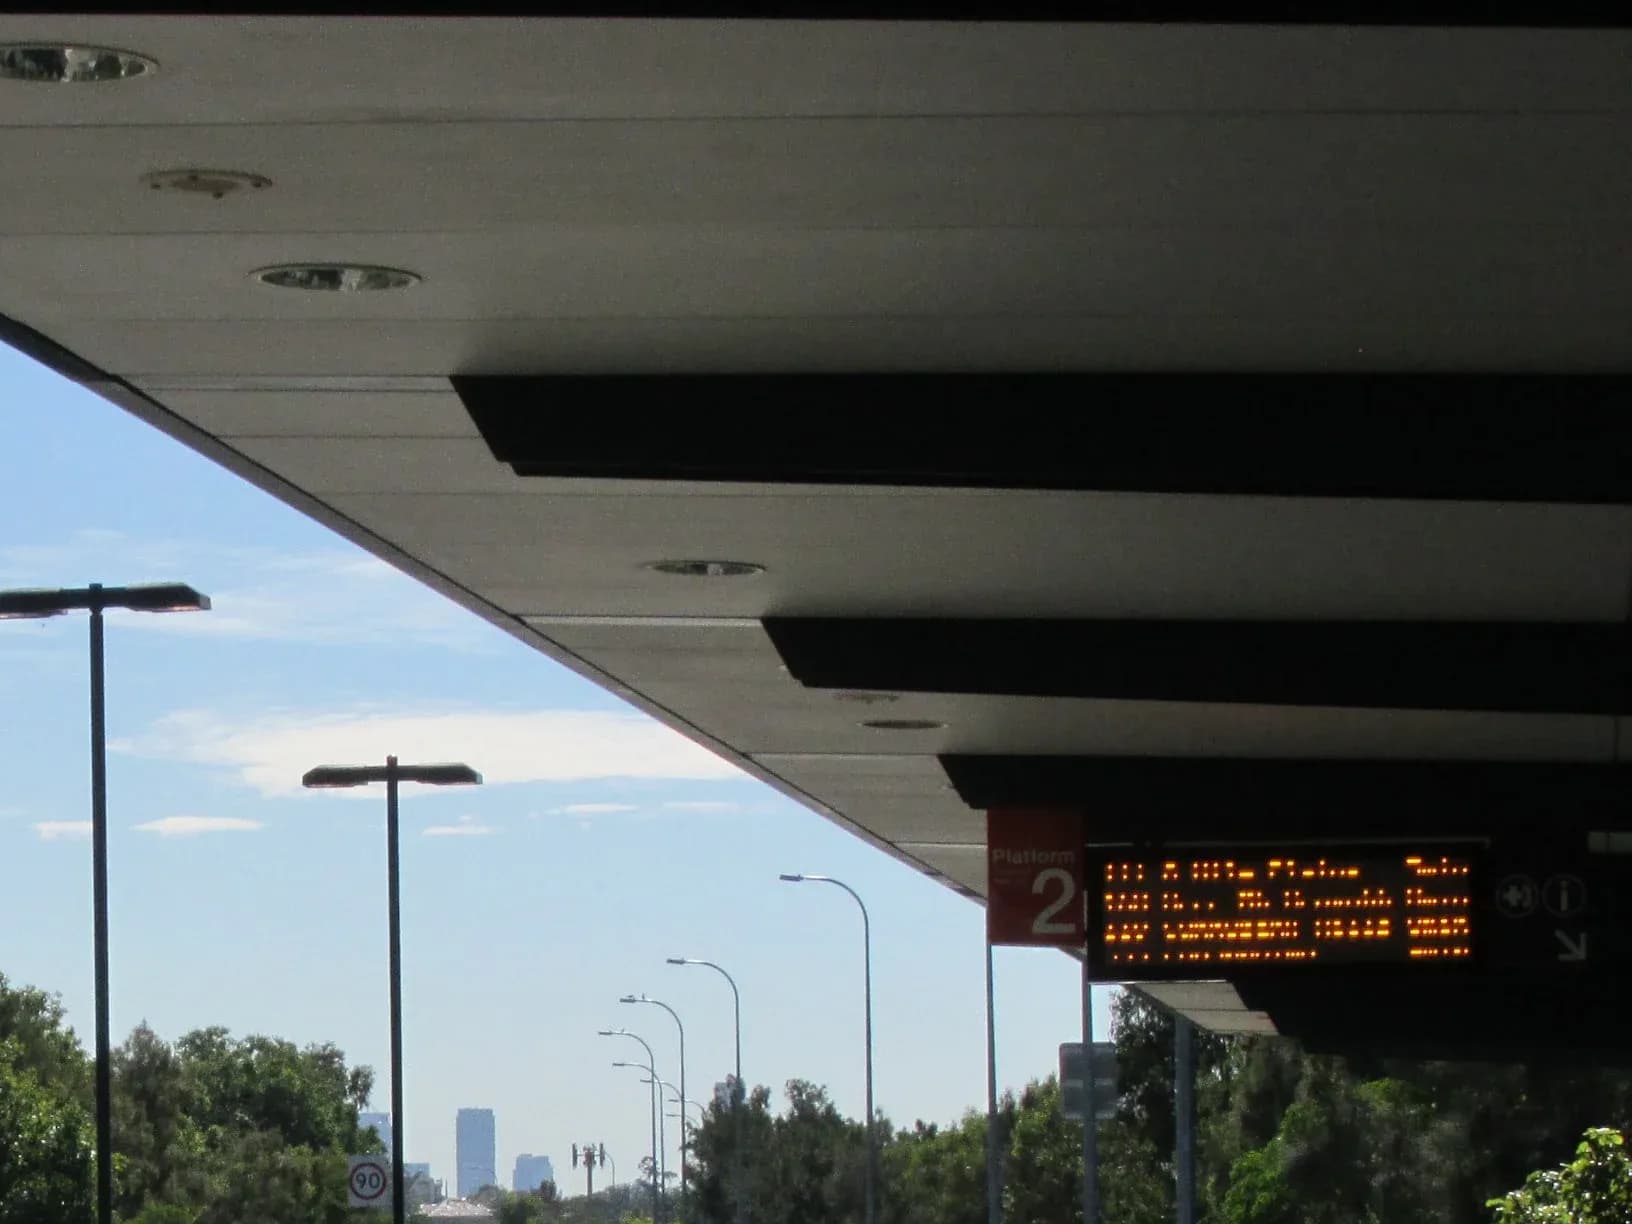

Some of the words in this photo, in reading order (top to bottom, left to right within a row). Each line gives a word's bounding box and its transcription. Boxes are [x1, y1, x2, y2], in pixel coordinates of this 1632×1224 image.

[992, 848, 1074, 864] Platform
[1032, 868, 1076, 934] 2
[356, 1172, 380, 1189] 90
